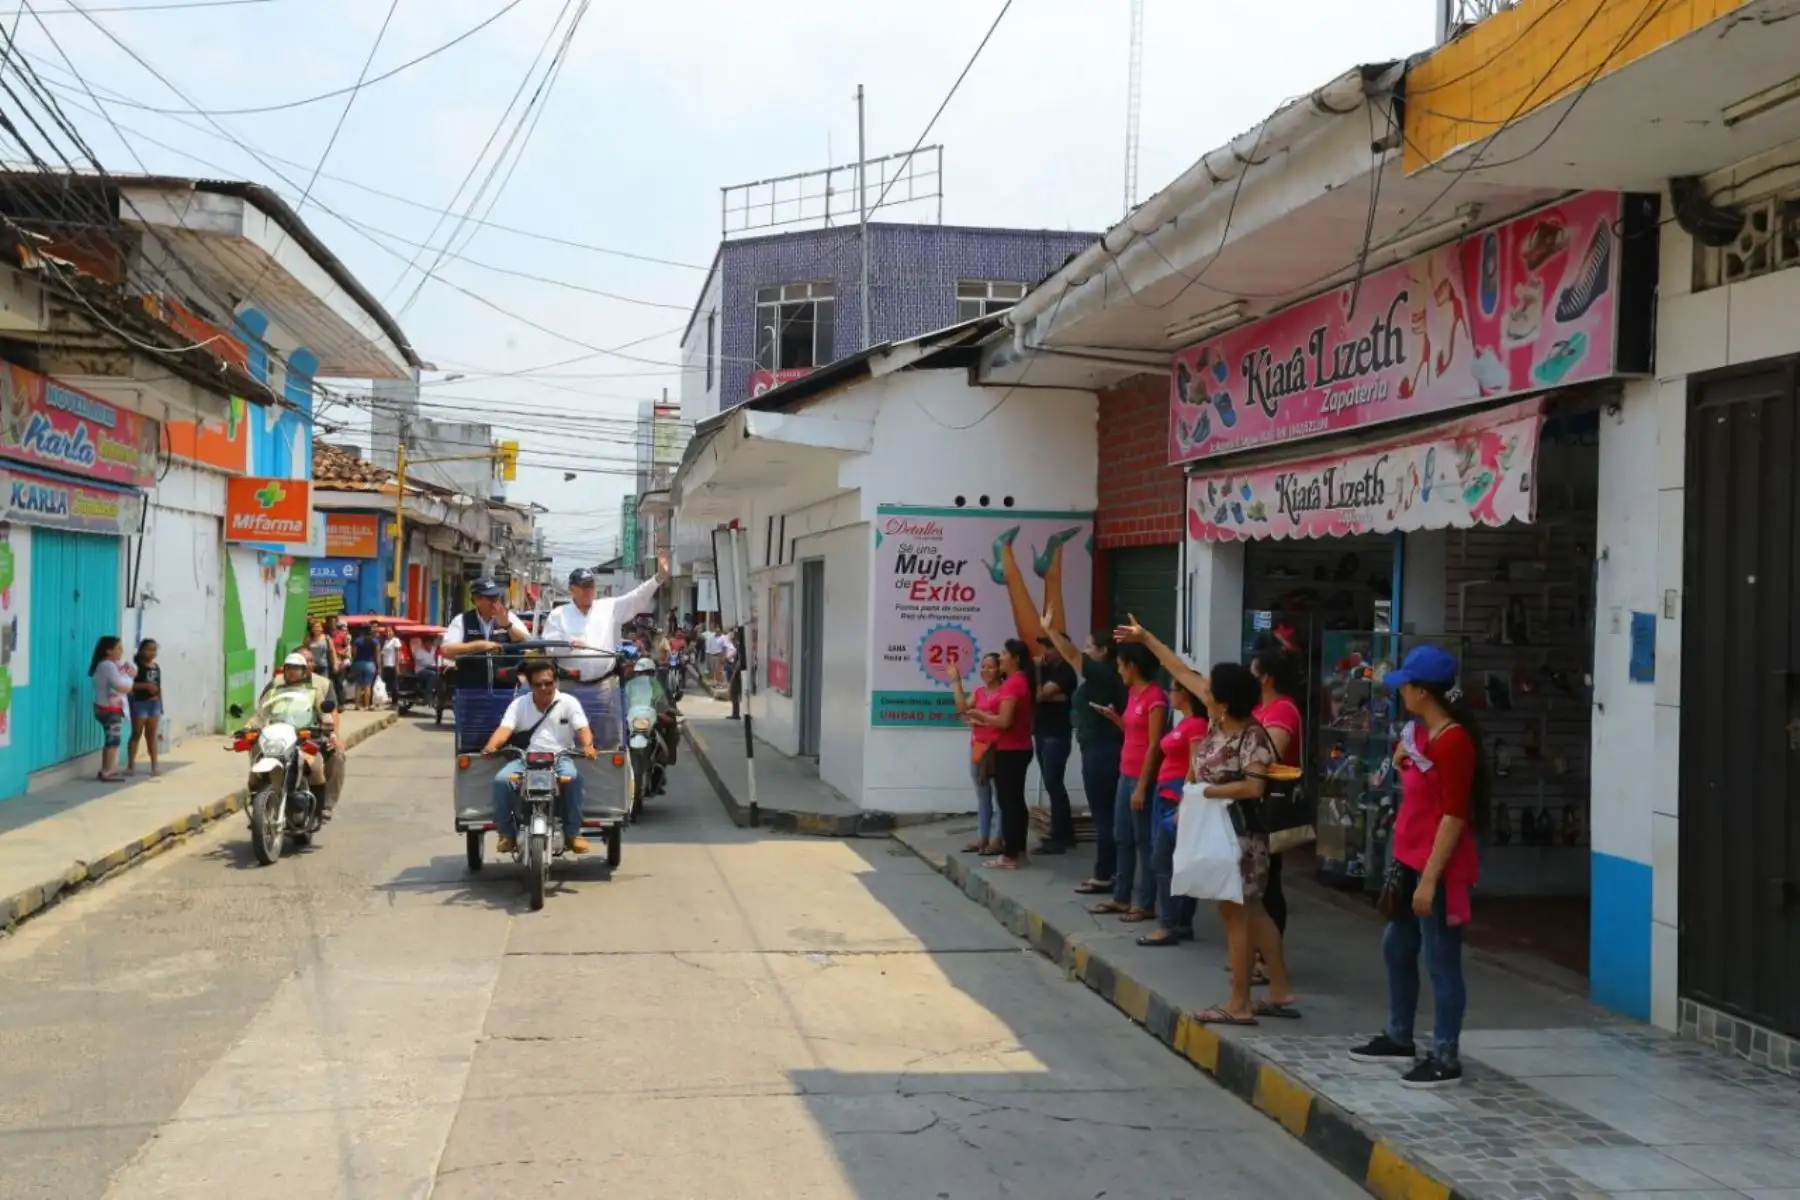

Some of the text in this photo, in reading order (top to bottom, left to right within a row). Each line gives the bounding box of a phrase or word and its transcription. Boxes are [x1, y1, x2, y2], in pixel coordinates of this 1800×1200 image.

[1309, 290, 1408, 388] Lizeth
[23, 412, 95, 467] Karla
[11, 481, 68, 515] KARLA
[232, 513, 303, 531] Mifarma
[884, 517, 943, 535] Detalles
[917, 545, 938, 555] una
[895, 554, 967, 580] Mujer
[895, 575, 976, 602] de Éxito
[929, 645, 960, 664] 25
